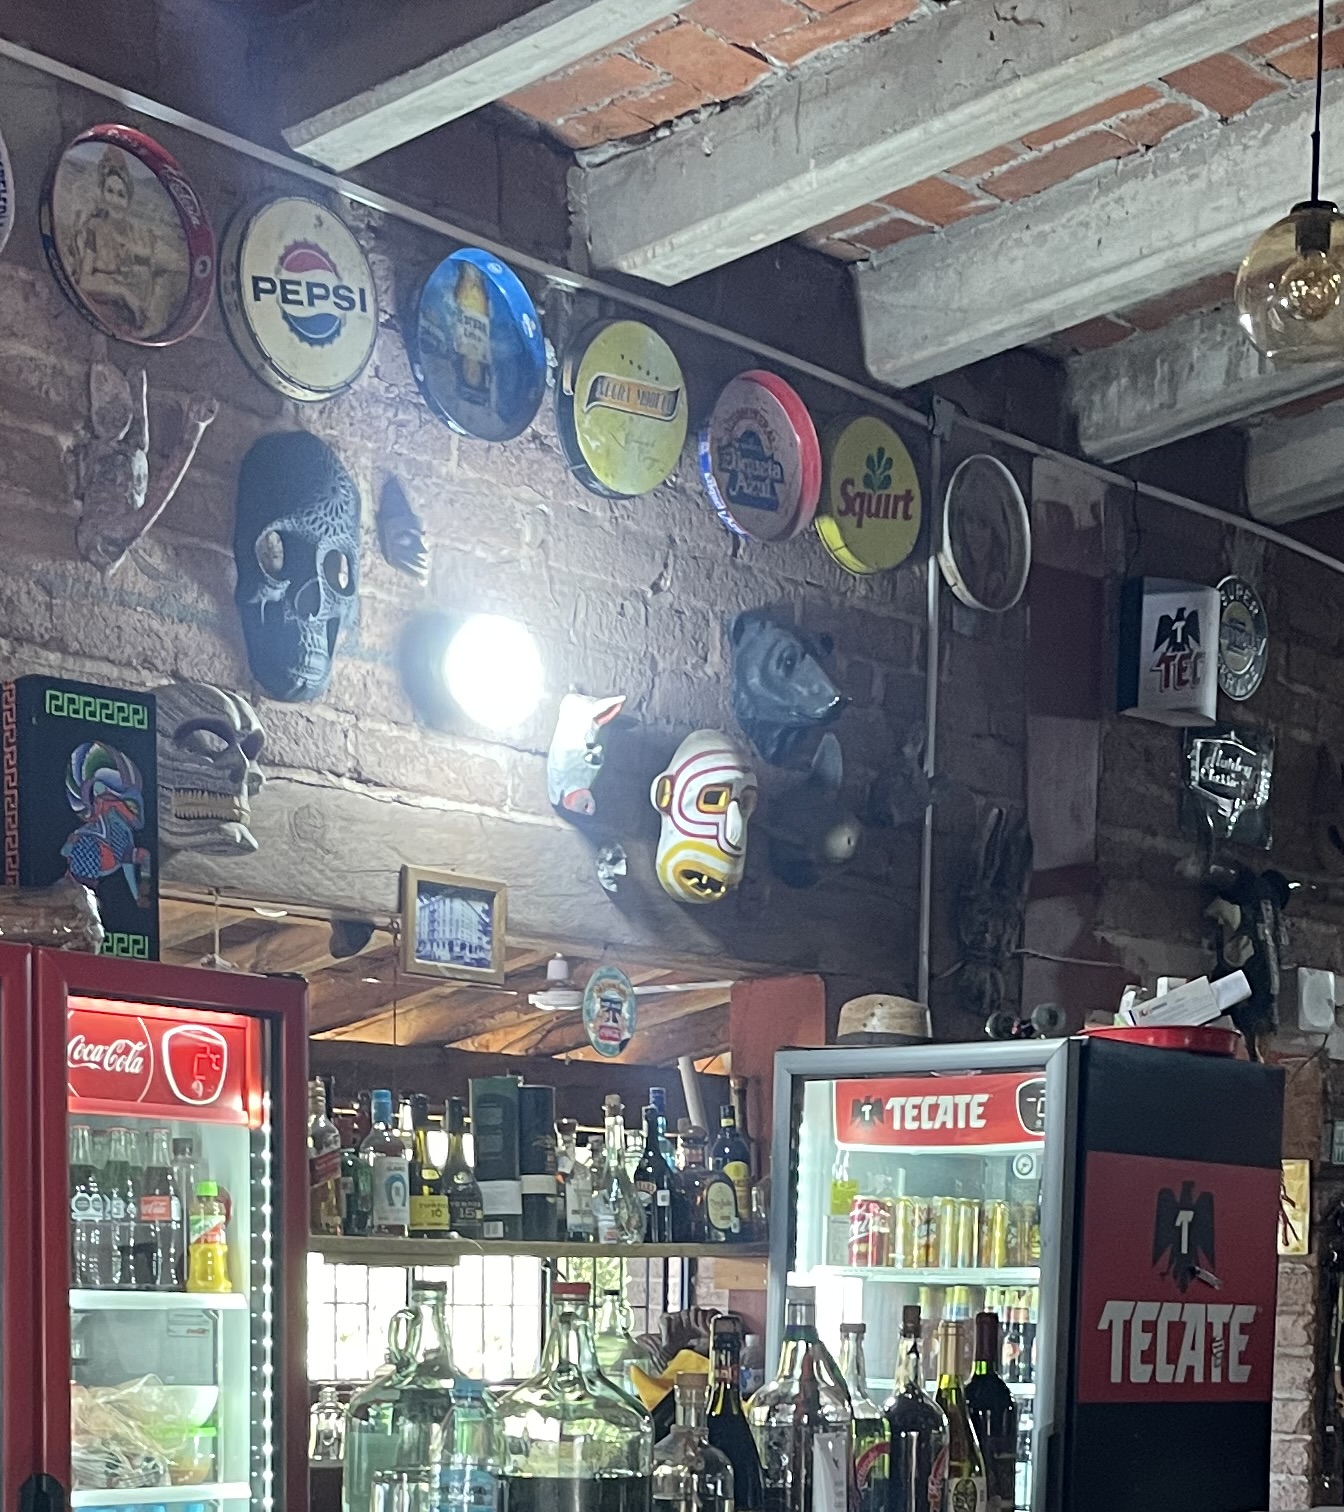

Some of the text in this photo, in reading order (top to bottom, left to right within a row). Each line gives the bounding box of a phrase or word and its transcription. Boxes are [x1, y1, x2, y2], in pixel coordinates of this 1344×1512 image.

[251, 275, 368, 313] PEPSI
[838, 478, 914, 528] Squirt
[67, 1034, 147, 1075] Coca-Cola
[885, 1093, 990, 1131] TECATE
[1097, 1300, 1257, 1383] TECATE
